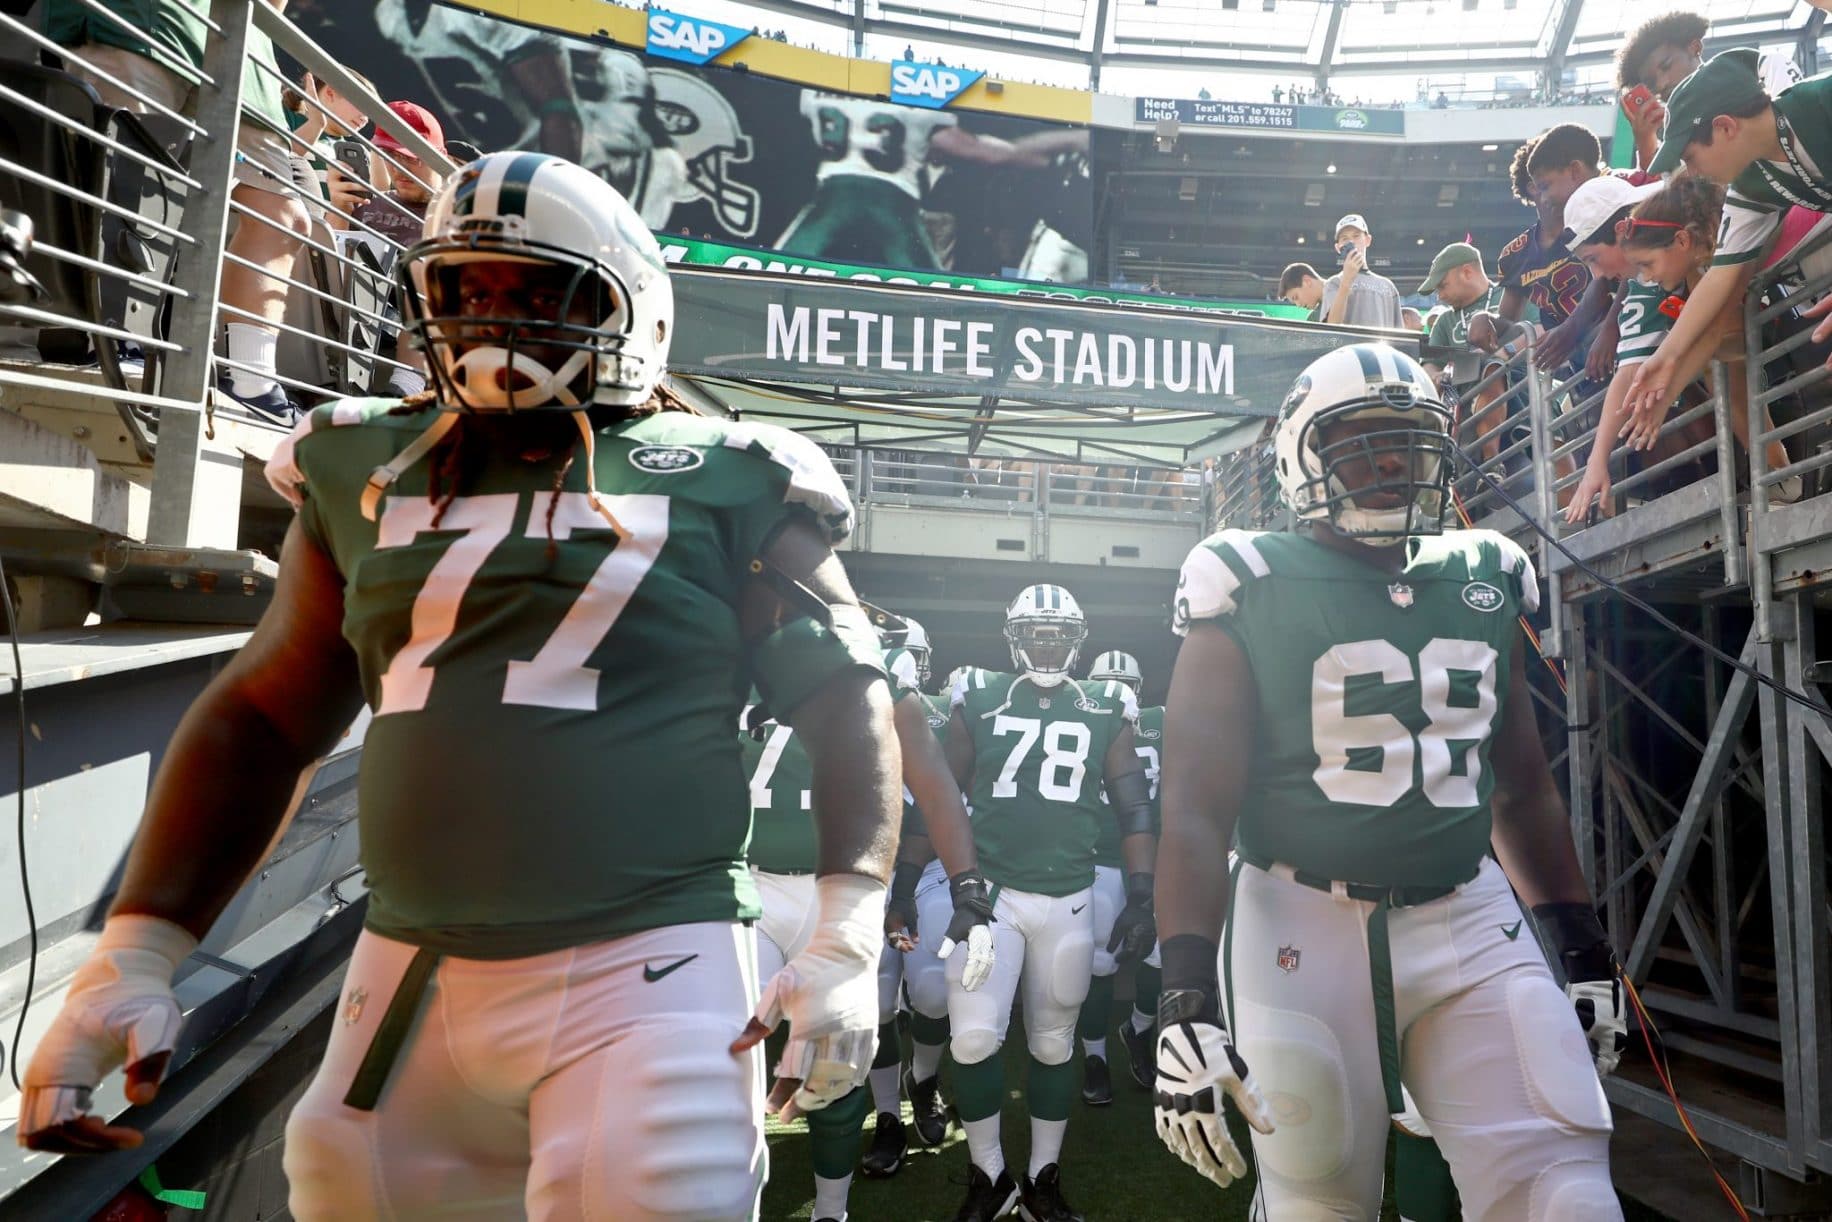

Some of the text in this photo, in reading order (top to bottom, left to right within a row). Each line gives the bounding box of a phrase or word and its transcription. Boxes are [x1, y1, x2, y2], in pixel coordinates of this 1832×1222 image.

[649, 16, 725, 55] SAP
[892, 67, 961, 99] SAP
[1144, 98, 1175, 110] Need
[1144, 109, 1180, 121] Help?
[1194, 103, 1216, 113] Text
[1251, 107, 1262, 115] to
[1262, 107, 1293, 117] 78247
[1207, 114, 1226, 123] call
[1227, 114, 1293, 126] 201.559.1515
[1780, 137, 1798, 163] JETS
[1795, 163, 1815, 187] YORK
[765, 303, 994, 378] METLIFE
[1013, 327, 1235, 395] STADIUM
[375, 491, 671, 717] 77
[1311, 637, 1498, 808] 68
[992, 715, 1092, 803] 78
